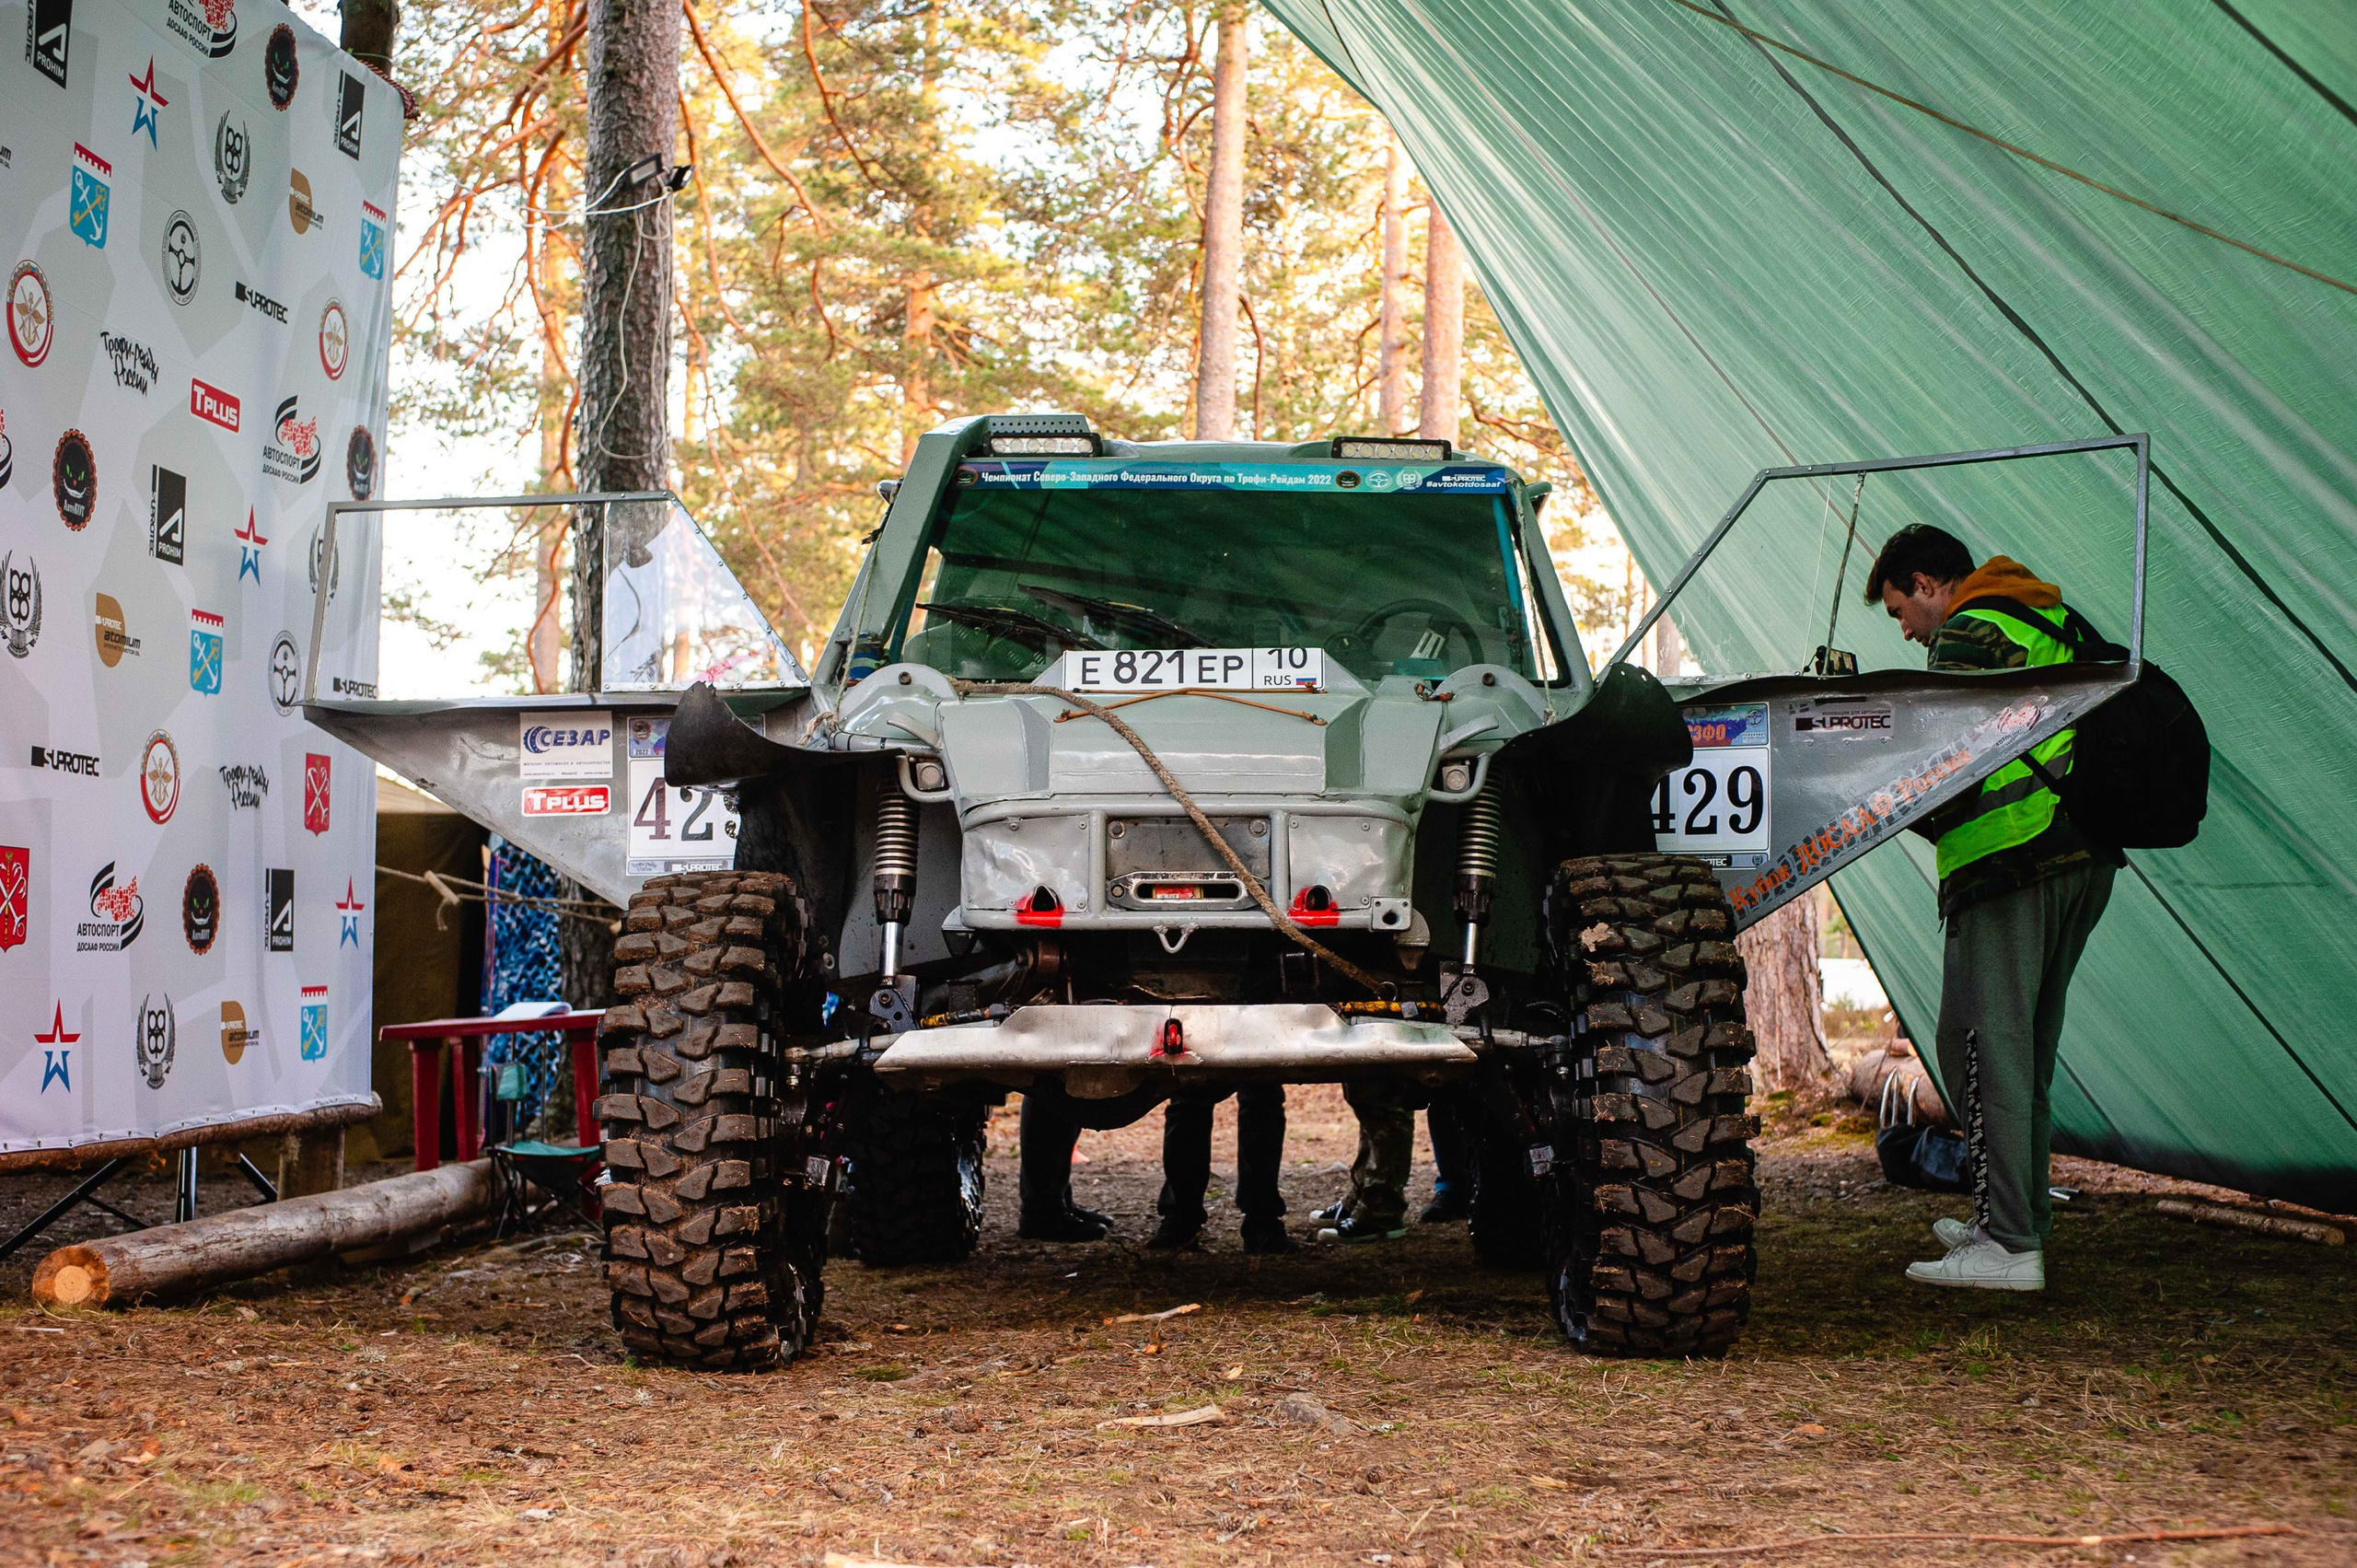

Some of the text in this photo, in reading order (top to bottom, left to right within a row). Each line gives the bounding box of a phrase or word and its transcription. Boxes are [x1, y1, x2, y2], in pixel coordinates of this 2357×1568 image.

[167, 17, 188, 40] ДОСААФ
[168, 0, 212, 41] АВТОСПОРТ
[37, 51, 64, 80] PROHIM
[245, 285, 288, 325] SUPROTEC
[193, 385, 238, 427] TPLUS
[262, 446, 301, 470] АВТОСПОРТ
[981, 470, 1332, 486] Чемпионат Северо-Западного Федерального Округа по Трофи-Рейдам 2022
[157, 541, 181, 559] PROHIM
[104, 631, 141, 649] atomium
[1112, 650, 1185, 685] 821
[1267, 647, 1308, 669] 10
[341, 678, 377, 700] SUPROTEC
[1263, 674, 1292, 686] RUS
[1812, 714, 1891, 730] SUPROTEC
[538, 729, 611, 747] СЕЗАР
[43, 748, 100, 777] SUPROTEC
[528, 792, 606, 812] TPLUS
[633, 777, 740, 842] 42
[1727, 748, 1975, 912] Кубок ДОСААФ России
[76, 923, 121, 937] АВТОСПОРТ
[76, 942, 120, 952] ДОСААФ РОССИИ
